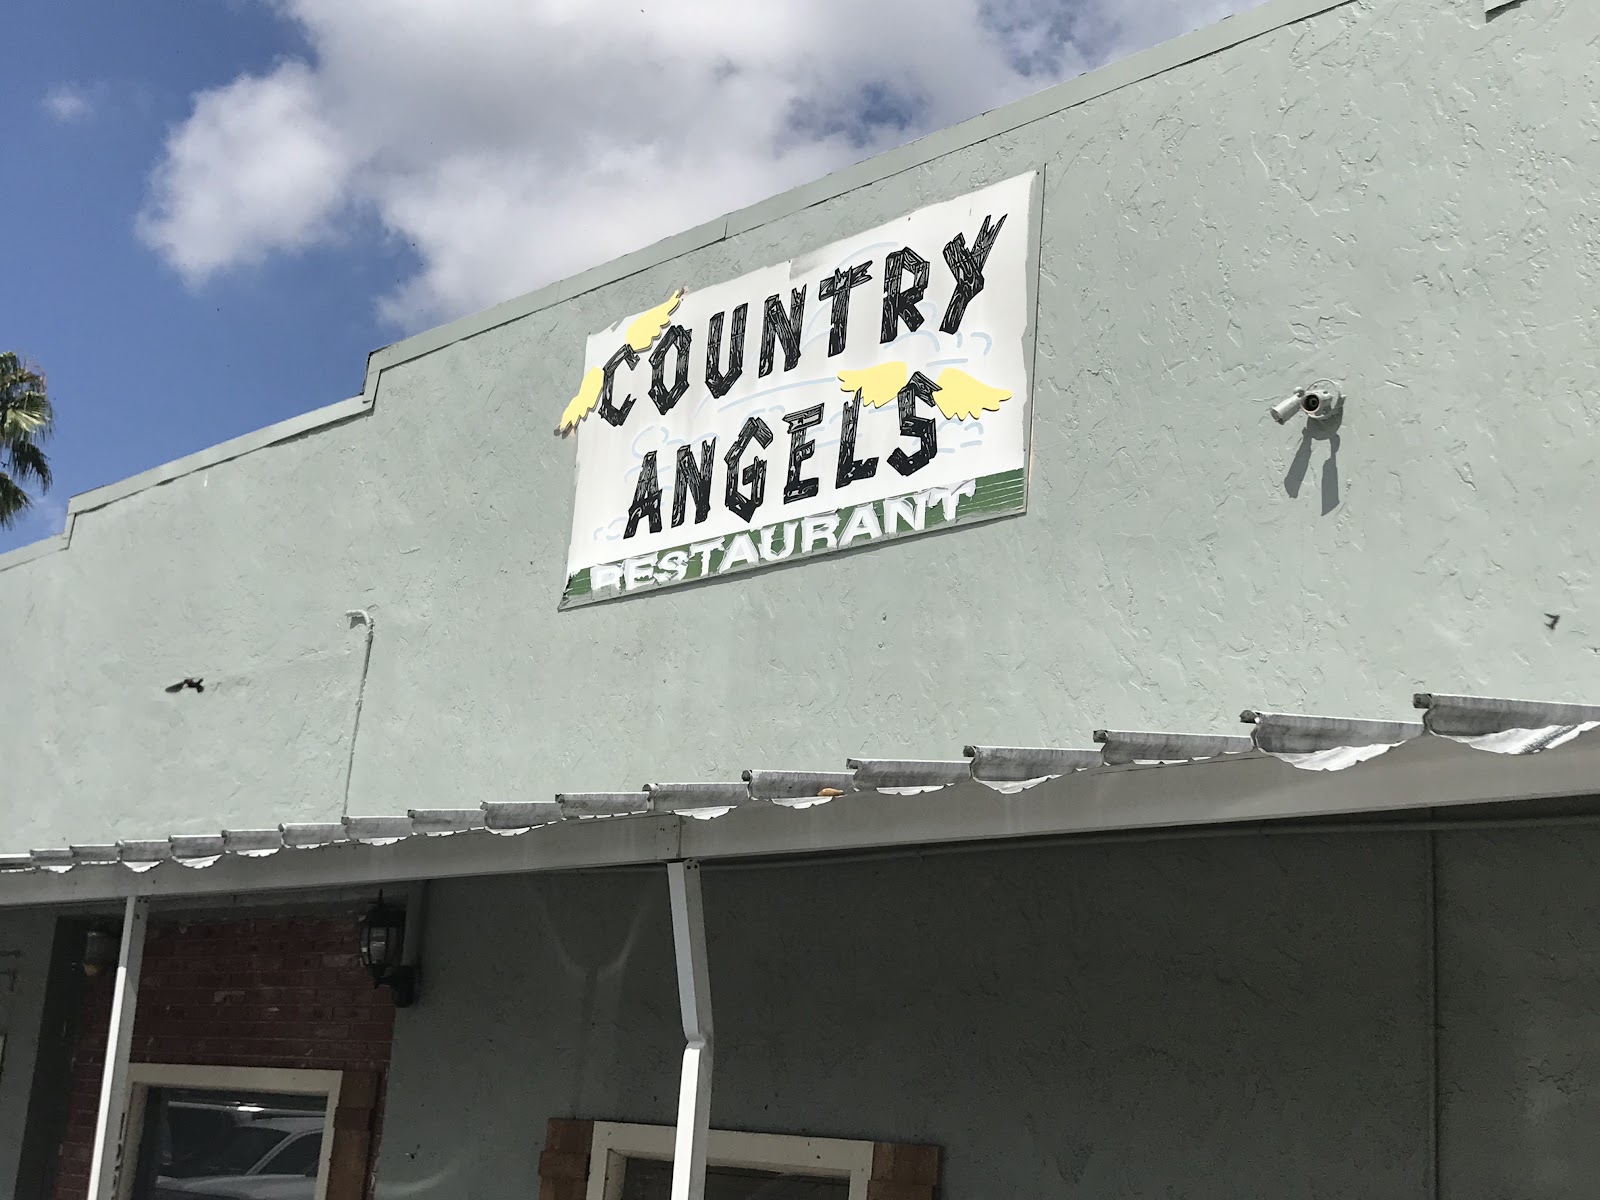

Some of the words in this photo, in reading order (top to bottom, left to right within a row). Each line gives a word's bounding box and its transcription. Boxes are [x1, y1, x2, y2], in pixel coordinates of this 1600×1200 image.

[598, 214, 1007, 426] COUNTRY
[590, 481, 976, 593] RESTAURANT
[623, 371, 942, 539] ANGELS
